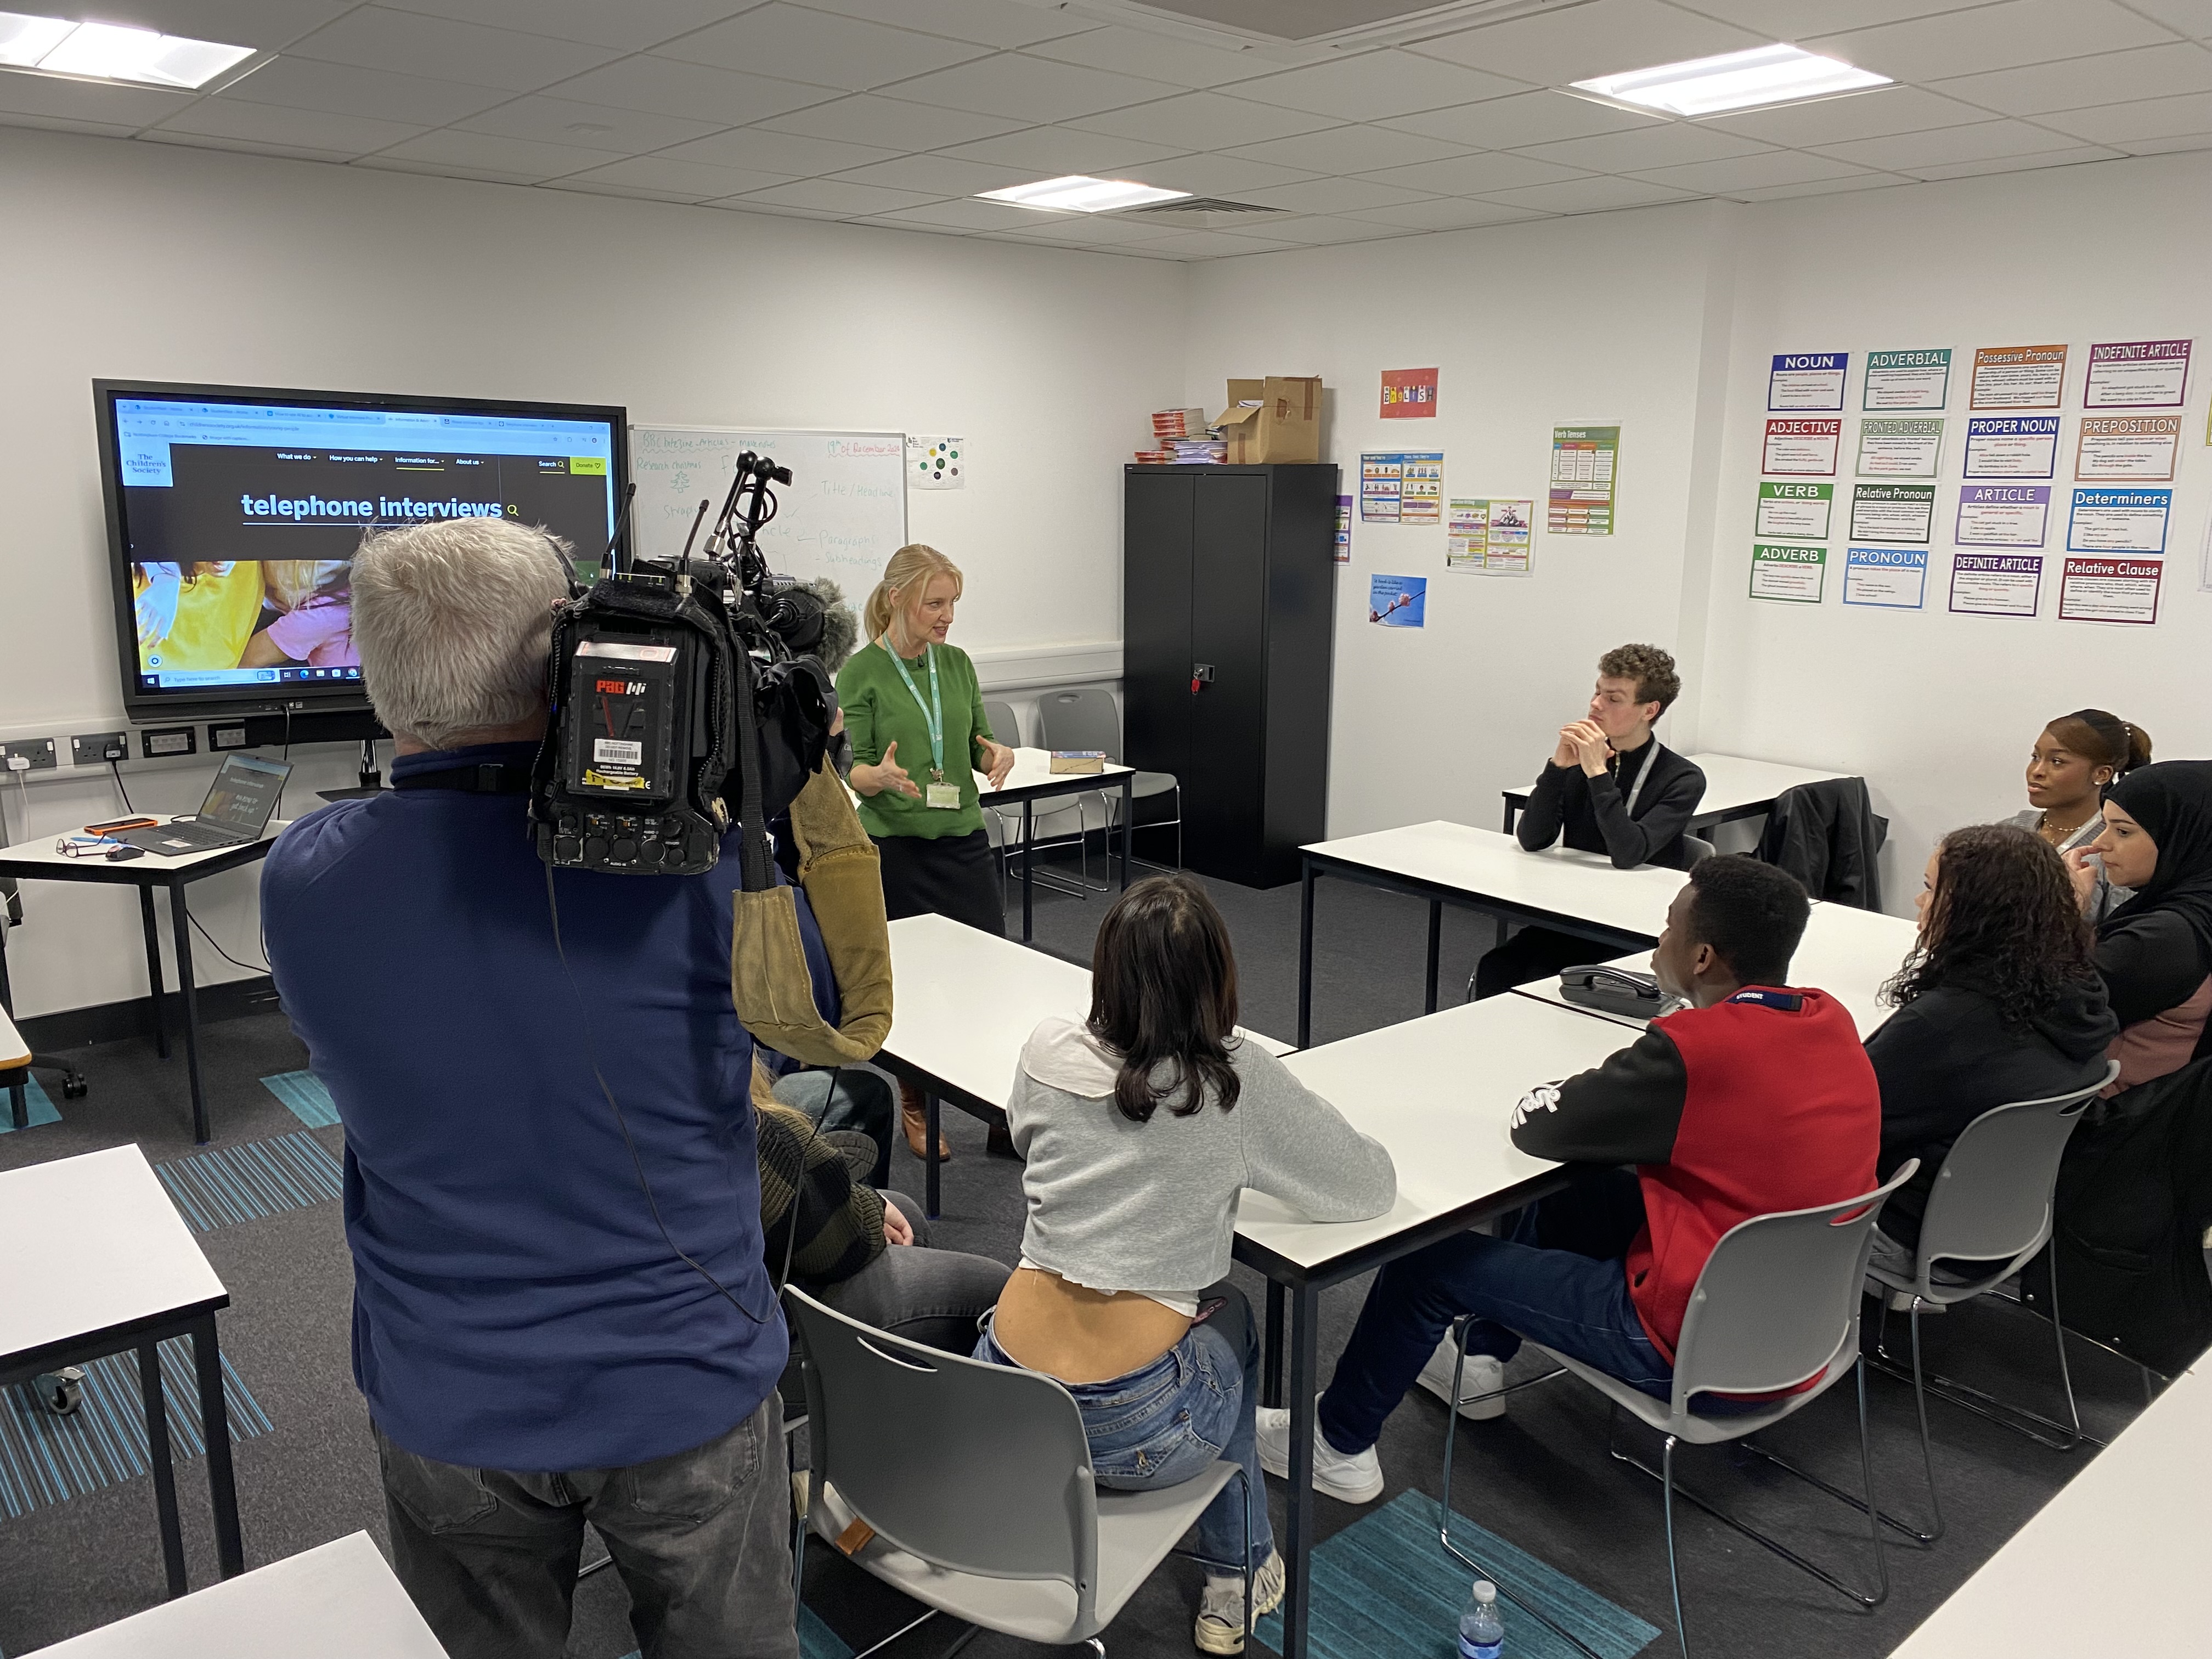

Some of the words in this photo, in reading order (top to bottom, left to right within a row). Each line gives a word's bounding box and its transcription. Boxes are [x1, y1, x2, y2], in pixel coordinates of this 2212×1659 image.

[1978, 349, 2023, 364] Possessive
[2025, 349, 2063, 361] Pronoun
[2093, 345, 2147, 360] INDEFINITE
[2148, 343, 2187, 357] ARTICLE
[1785, 356, 1834, 368] NOUN
[1870, 352, 1946, 366] ADVERBIAL
[1769, 422, 1838, 433] ADJECTIVE
[1864, 422, 1897, 433] FRONTED
[1899, 421, 1940, 433] ADVERBIAL
[1971, 420, 2017, 433] PROPER
[2021, 419, 2056, 432] NOUN
[2085, 419, 2178, 433] PREPOSITION
[1554, 430, 1566, 438] Verb
[1567, 430, 1586, 438] Tenses
[842, 442, 850, 454] of
[854, 442, 885, 453] December
[821, 481, 846, 494] Title
[1774, 485, 1819, 497] VERB
[1856, 487, 1891, 499] Relative
[1893, 488, 1932, 499] Pronoun
[1974, 489, 2035, 501] ARTICLE
[2075, 492, 2168, 505] Determiners
[241, 494, 373, 521] telephone
[380, 496, 502, 518] interviews
[1760, 548, 1819, 561] ADVERB
[1849, 551, 1925, 565] PRONOUN
[1956, 557, 1998, 569] DEFINITE
[2000, 558, 2039, 571] ARTICLE
[2067, 561, 2114, 574] Relative
[2118, 563, 2159, 576] Clause
